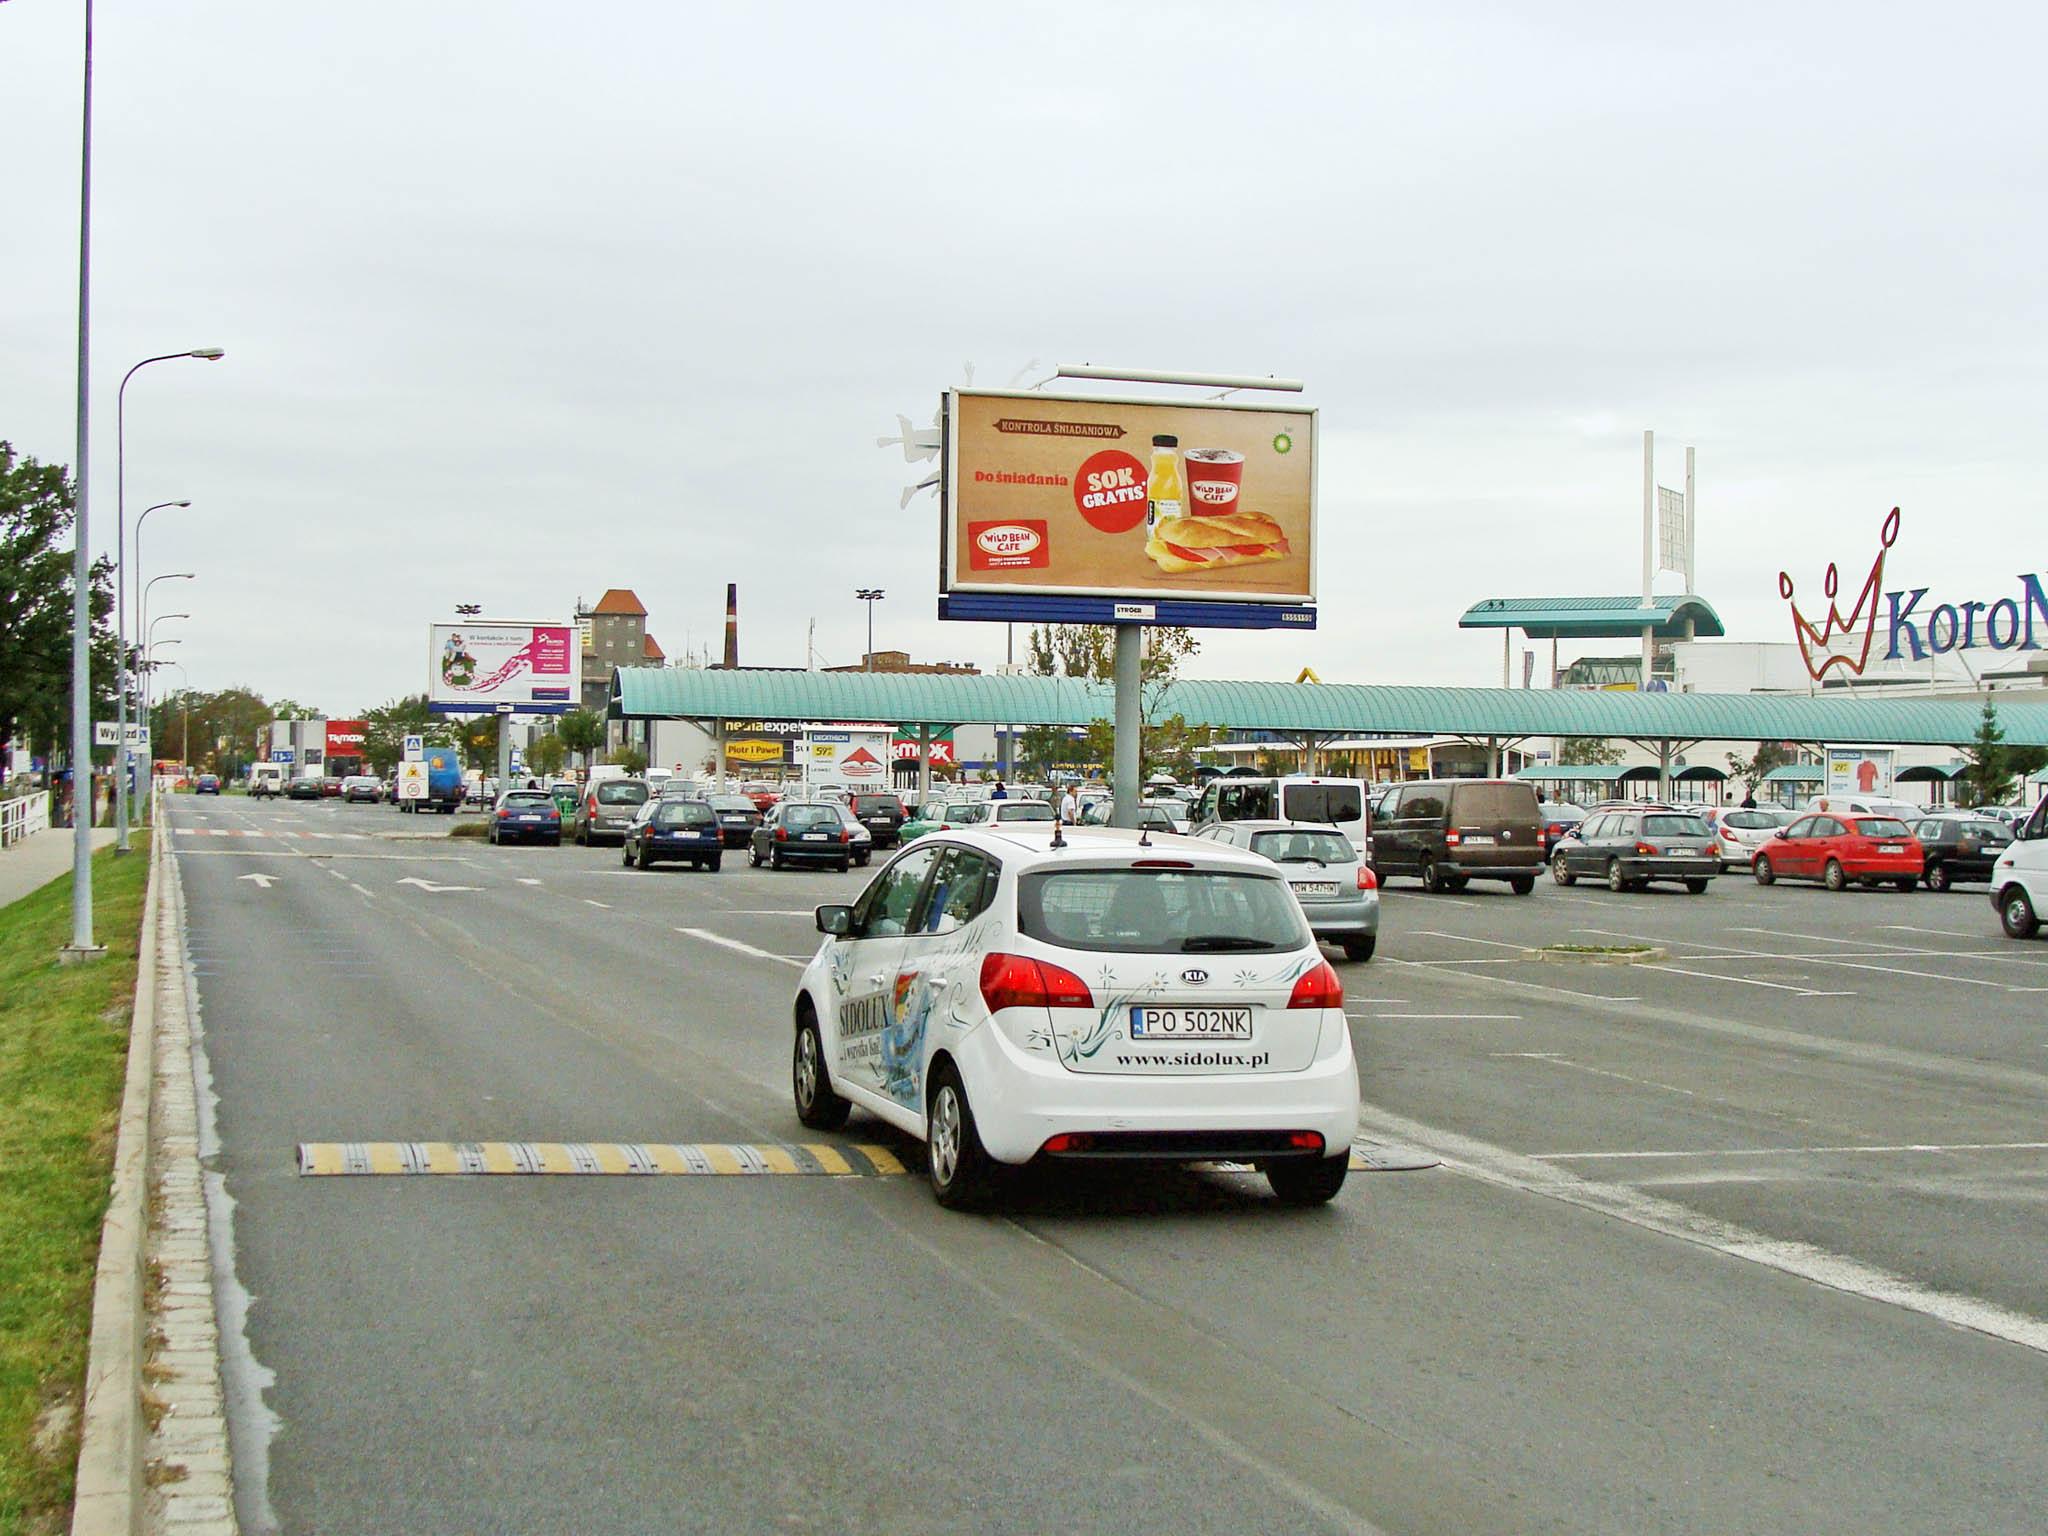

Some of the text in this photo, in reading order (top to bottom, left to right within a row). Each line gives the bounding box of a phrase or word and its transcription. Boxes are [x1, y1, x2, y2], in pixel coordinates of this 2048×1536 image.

[1002, 421, 1119, 436] KONTROLA ŚNIADANIOWA
[975, 471, 1068, 486] Do śniadania
[1087, 467, 1135, 491] SOK
[1009, 532, 1030, 542] BEAN
[997, 543, 1020, 552] CAFE
[100, 728, 137, 741] Wyjzd
[728, 745, 749, 754] Piotr
[1185, 971, 1206, 981] KIA
[839, 993, 889, 1037] SIDOLUX
[1147, 1011, 1247, 1032] PO 502NK
[1117, 1052, 1270, 1068] www.sidolux.pl
